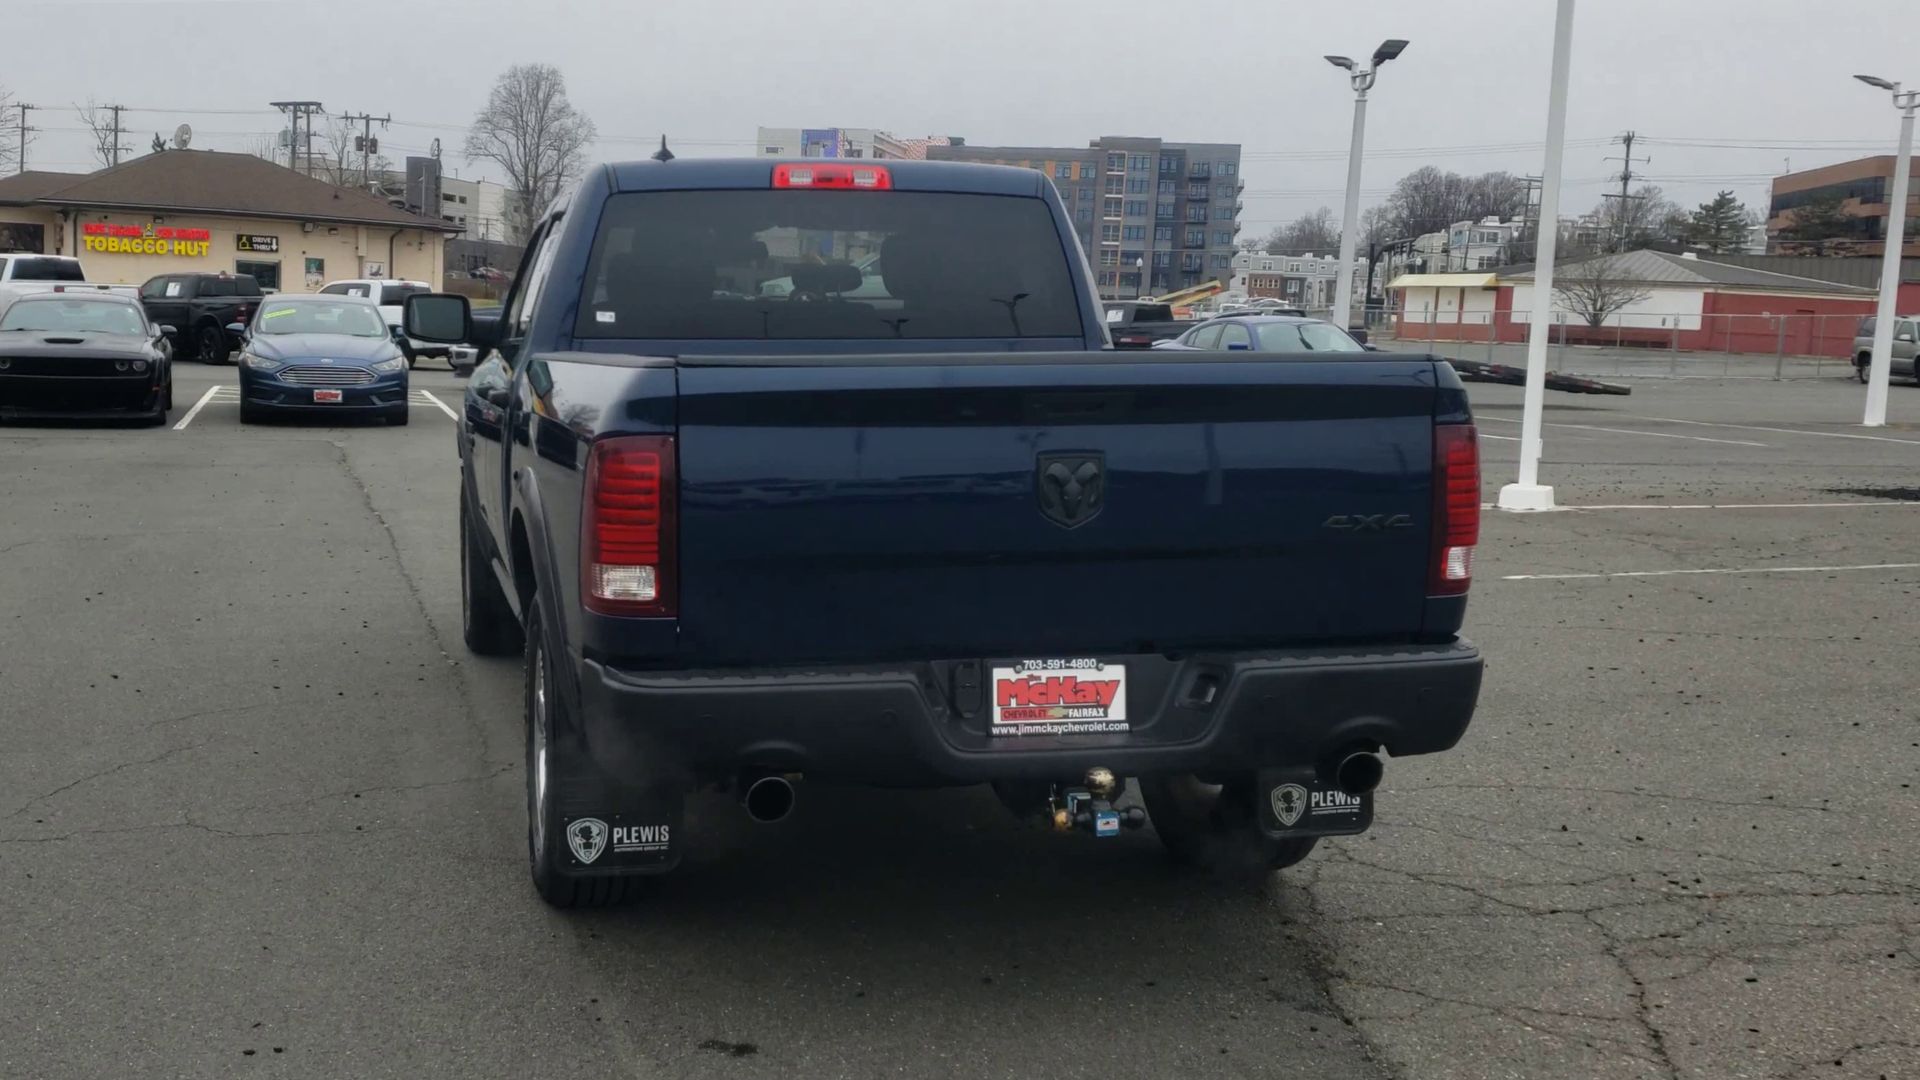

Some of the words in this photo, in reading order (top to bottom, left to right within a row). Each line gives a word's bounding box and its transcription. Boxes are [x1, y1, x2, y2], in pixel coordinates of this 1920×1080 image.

[83, 236, 169, 255] TOBACCO
[173, 240, 210, 256] HUT
[253, 243, 271, 251] THRU
[1023, 658, 1097, 670] 703-591-4800
[997, 675, 1121, 708] McKay
[1002, 709, 1047, 719] CHEVROLET
[1068, 707, 1105, 719] FAIRFAX
[992, 722, 1129, 736] www.jimmckaychevrolet.com
[613, 825, 669, 843] PLEWIS
